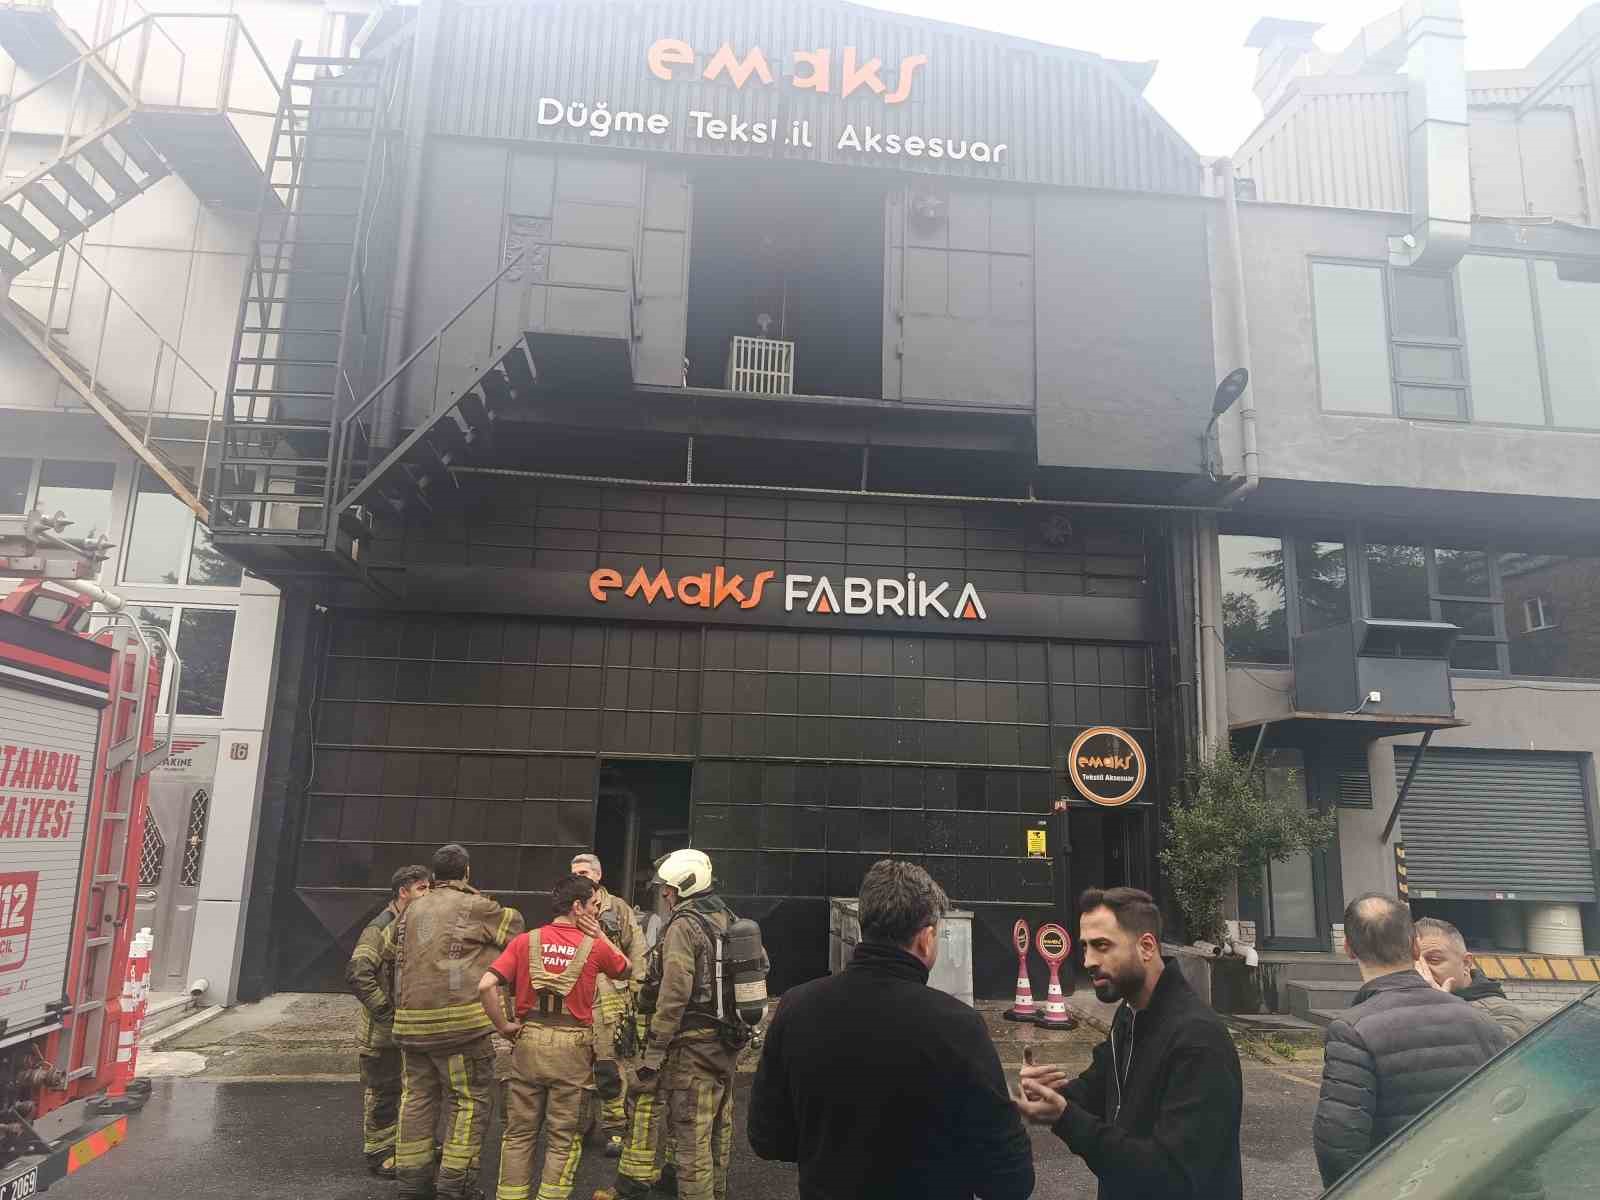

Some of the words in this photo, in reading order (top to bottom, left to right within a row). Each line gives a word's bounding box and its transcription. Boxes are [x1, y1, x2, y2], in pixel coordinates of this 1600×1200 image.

[537, 97, 671, 137] Düğme
[837, 124, 1008, 163] Aksesuar
[588, 565, 775, 609] emaks
[784, 572, 987, 620] FABRİKA
[0, 745, 80, 793] TANBUL
[230, 742, 249, 761] 16
[0, 883, 28, 929] 12
